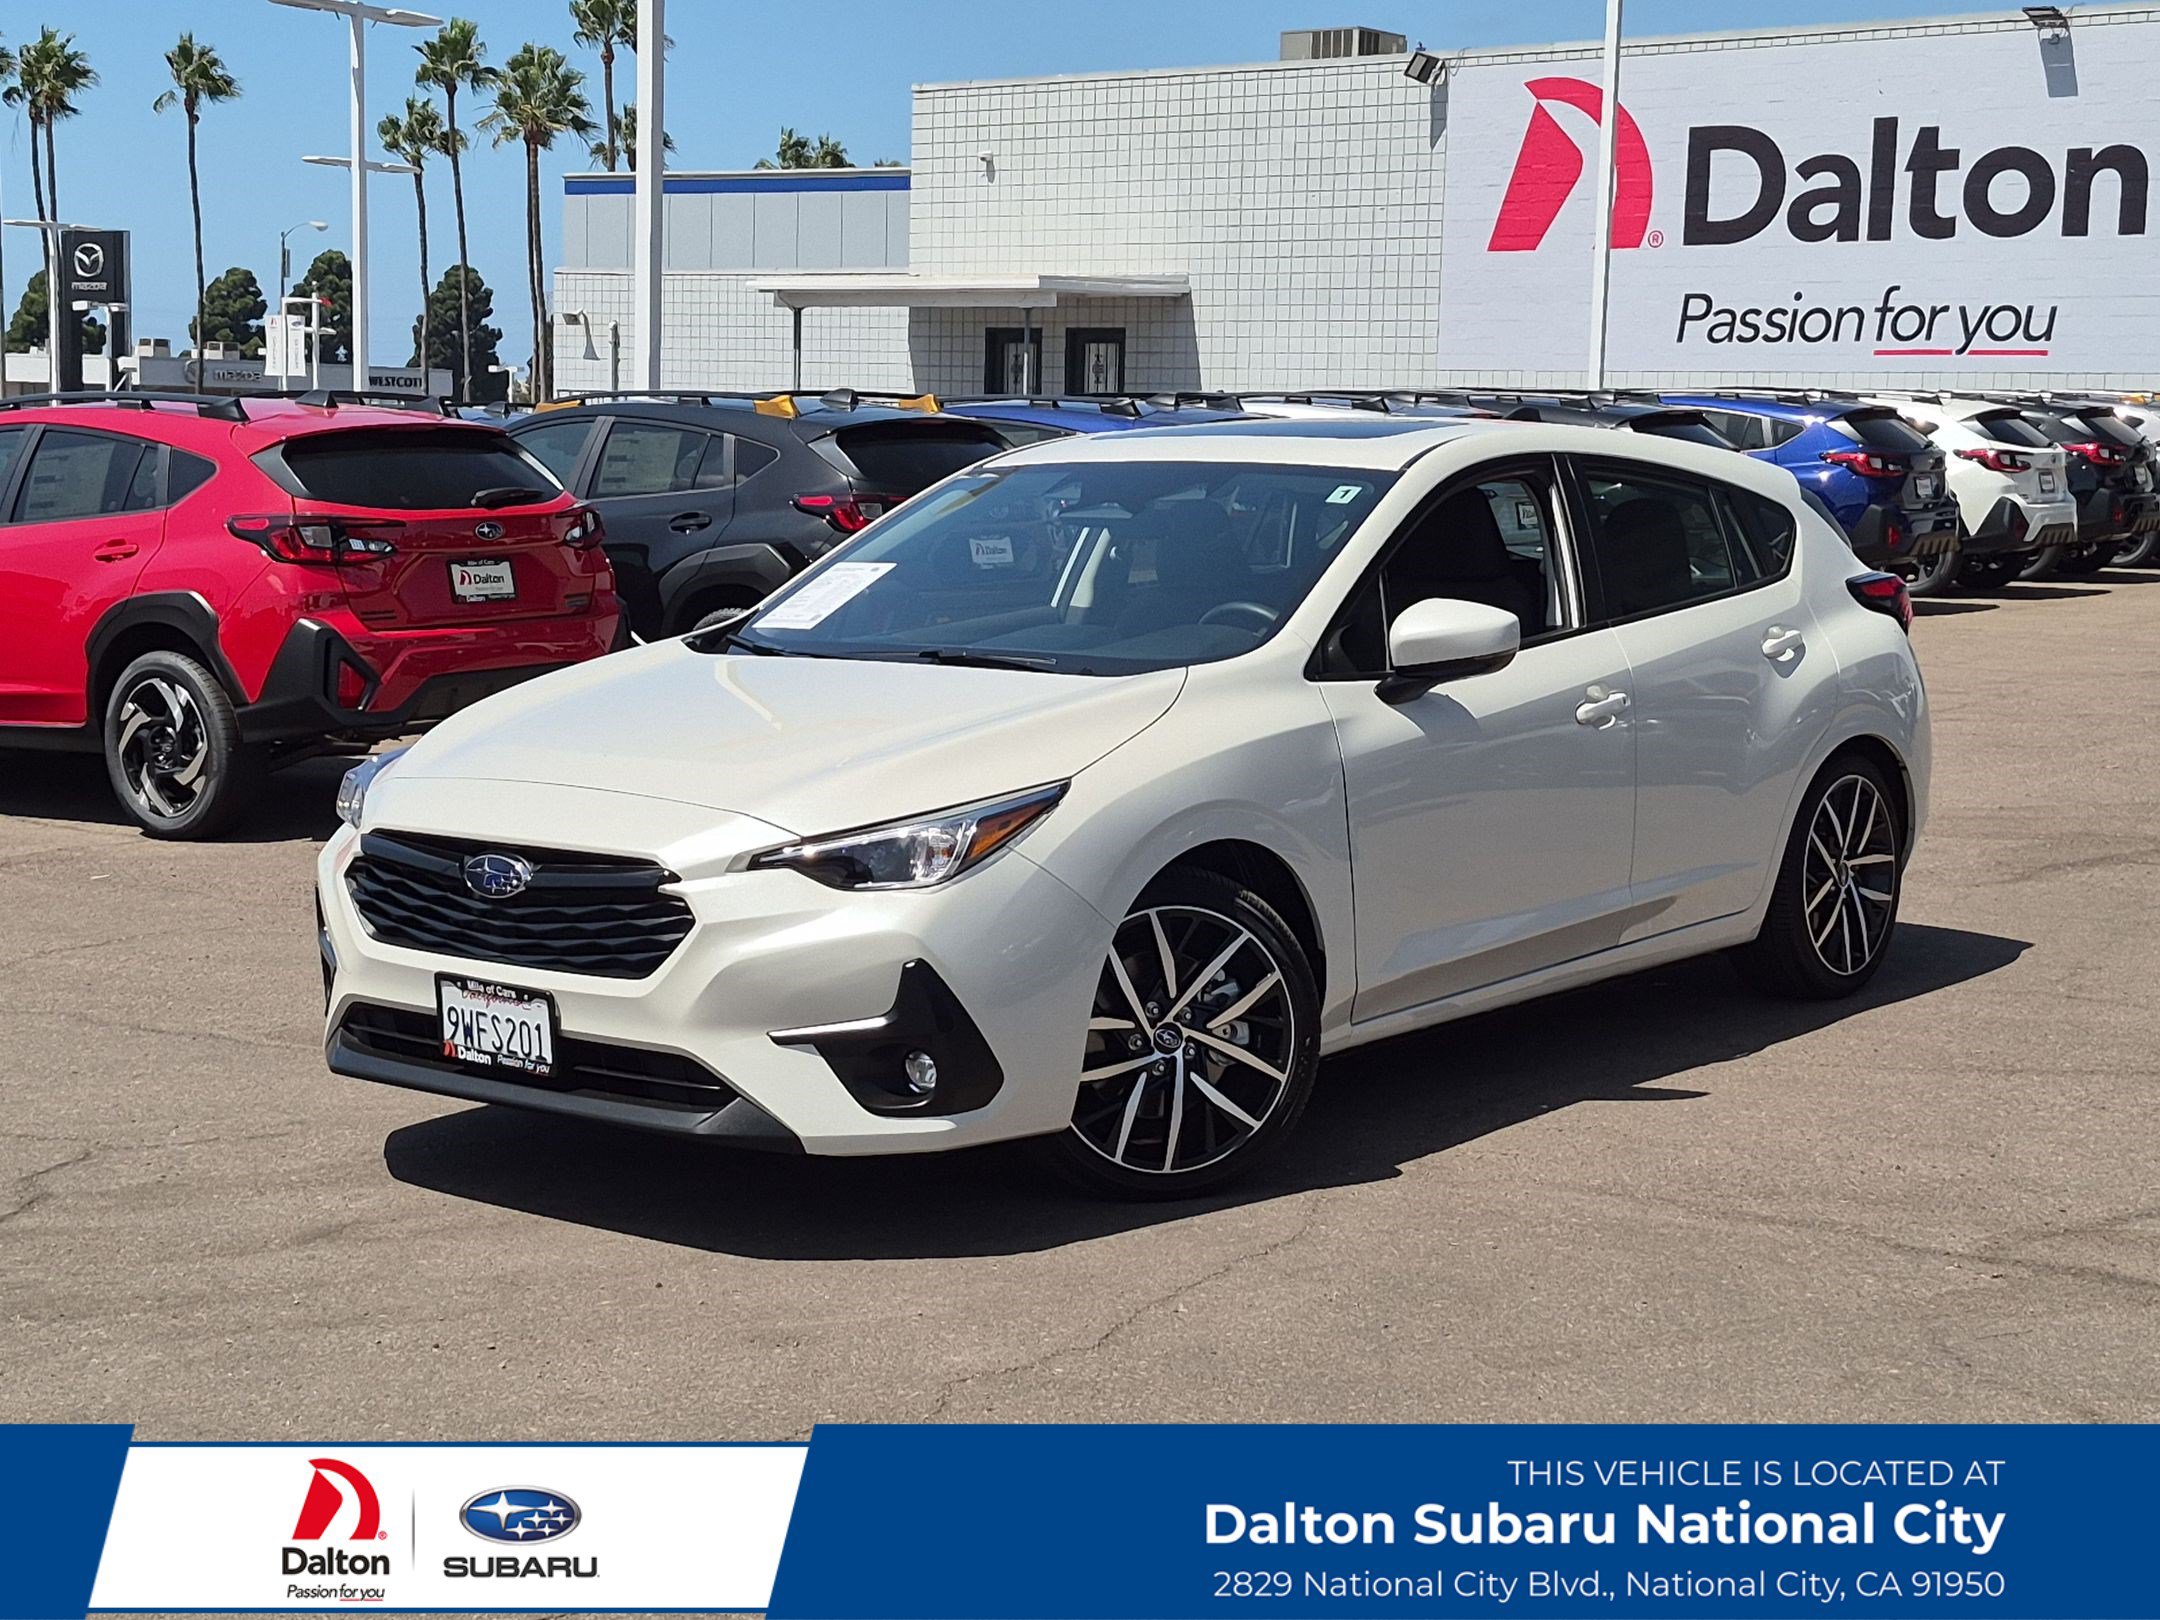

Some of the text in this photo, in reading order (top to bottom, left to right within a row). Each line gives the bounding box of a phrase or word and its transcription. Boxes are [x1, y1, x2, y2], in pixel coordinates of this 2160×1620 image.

[1683, 116, 2149, 246] Dalton
[1676, 285, 2058, 356] Passion for you
[1339, 489, 1352, 499] 1
[473, 572, 505, 584] Dalton
[485, 985, 495, 995] of
[496, 986, 517, 999] Cars
[446, 1005, 548, 1062] 9WFS201
[457, 1044, 492, 1066] Dalton
[536, 1063, 551, 1074] you
